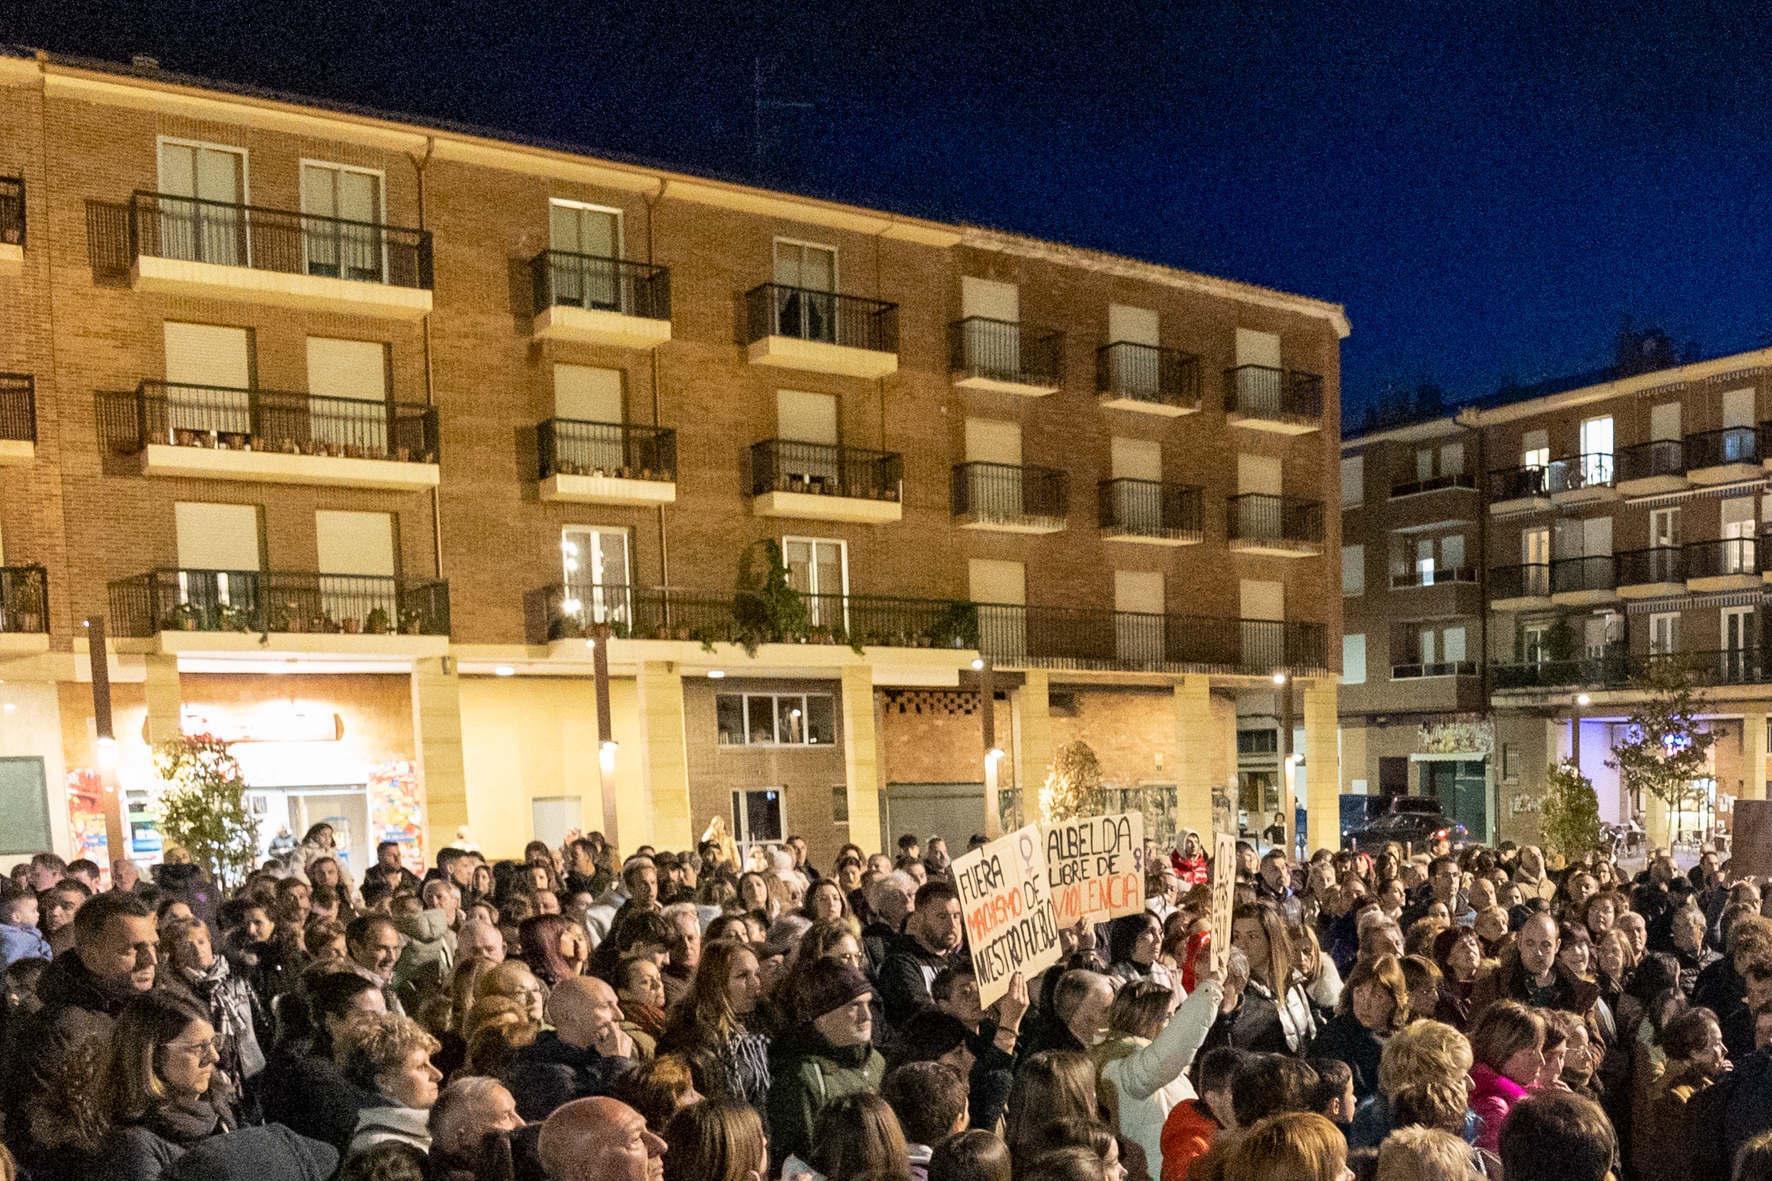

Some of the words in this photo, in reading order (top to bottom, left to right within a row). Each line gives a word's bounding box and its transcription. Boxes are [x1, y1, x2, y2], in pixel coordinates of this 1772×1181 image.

[1047, 816, 1132, 864] ALBELDA
[959, 854, 1005, 904] FUERA
[1096, 854, 1120, 876] DE
[1023, 874, 1043, 910] DE
[1051, 873, 1139, 918] VIOLENCIA
[975, 925, 1023, 986] NUESTRO
[1020, 898, 1058, 960] PUEBLO
